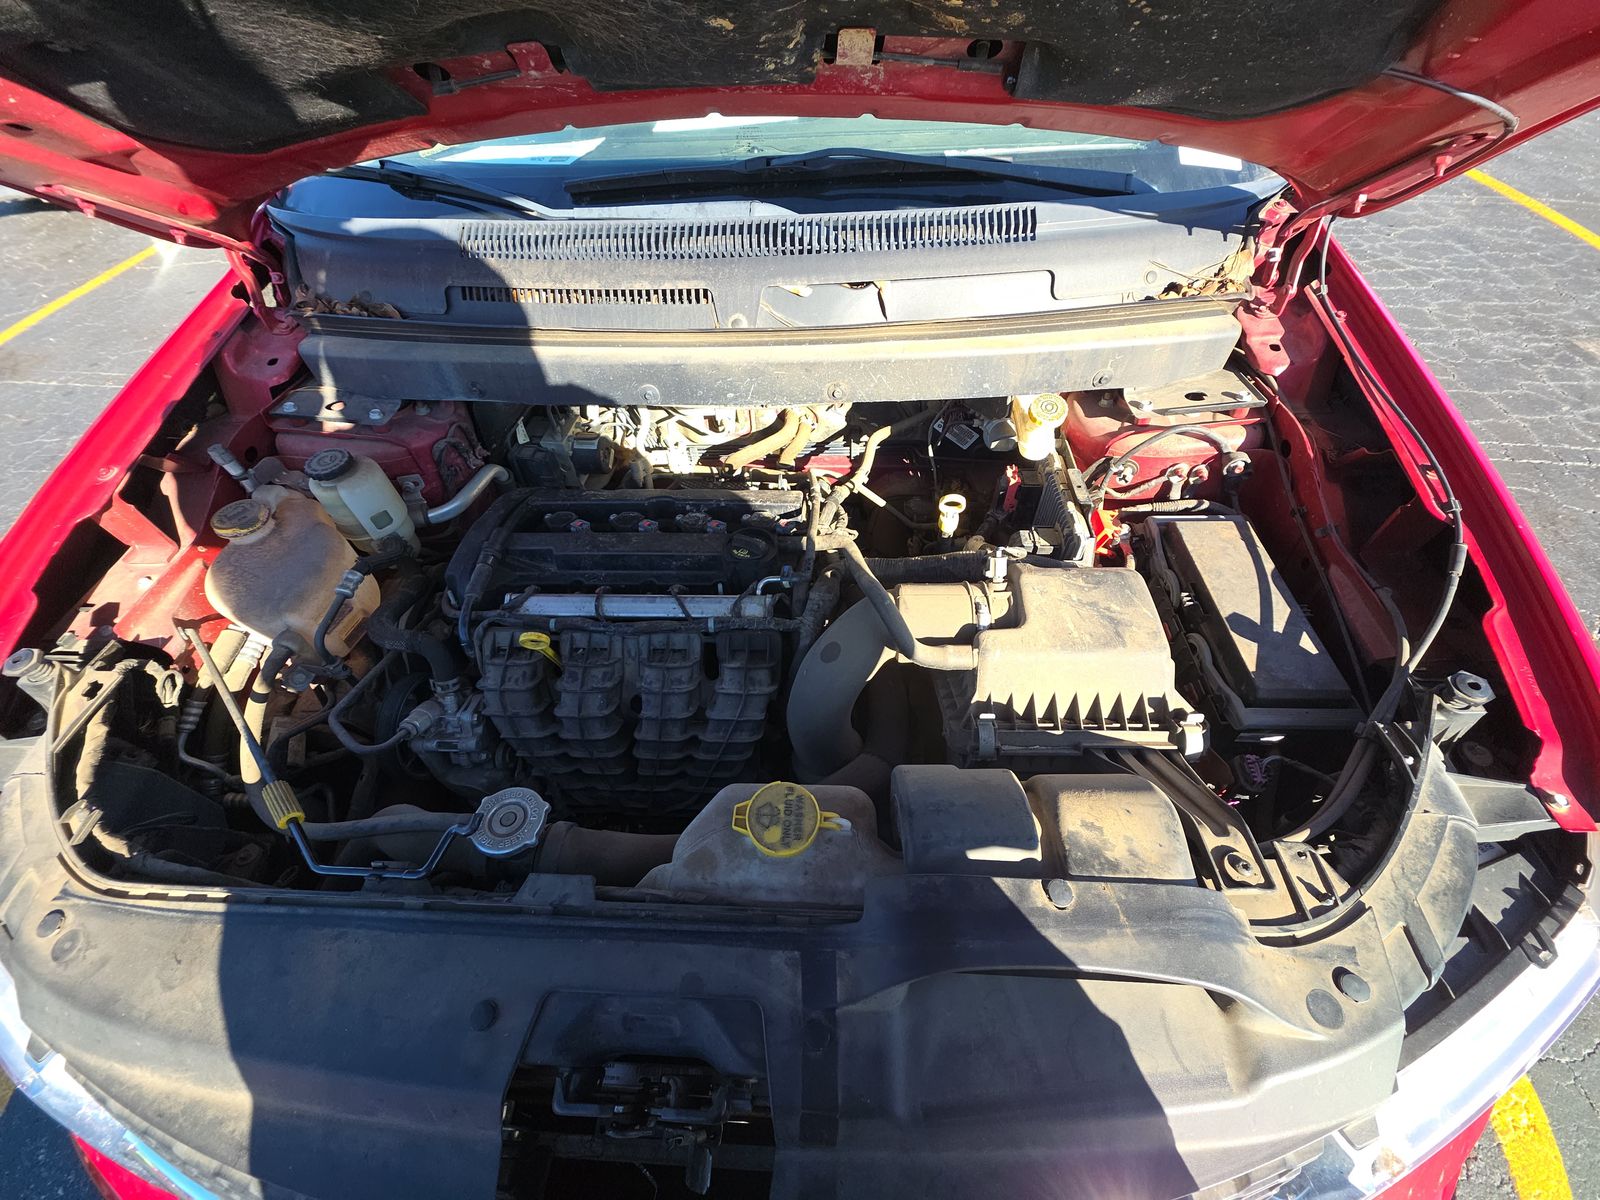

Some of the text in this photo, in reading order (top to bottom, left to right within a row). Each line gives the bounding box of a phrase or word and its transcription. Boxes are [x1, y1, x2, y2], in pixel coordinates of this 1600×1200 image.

[781, 787, 794, 848] FLUID ONLY
[793, 795, 804, 841] WASHER
